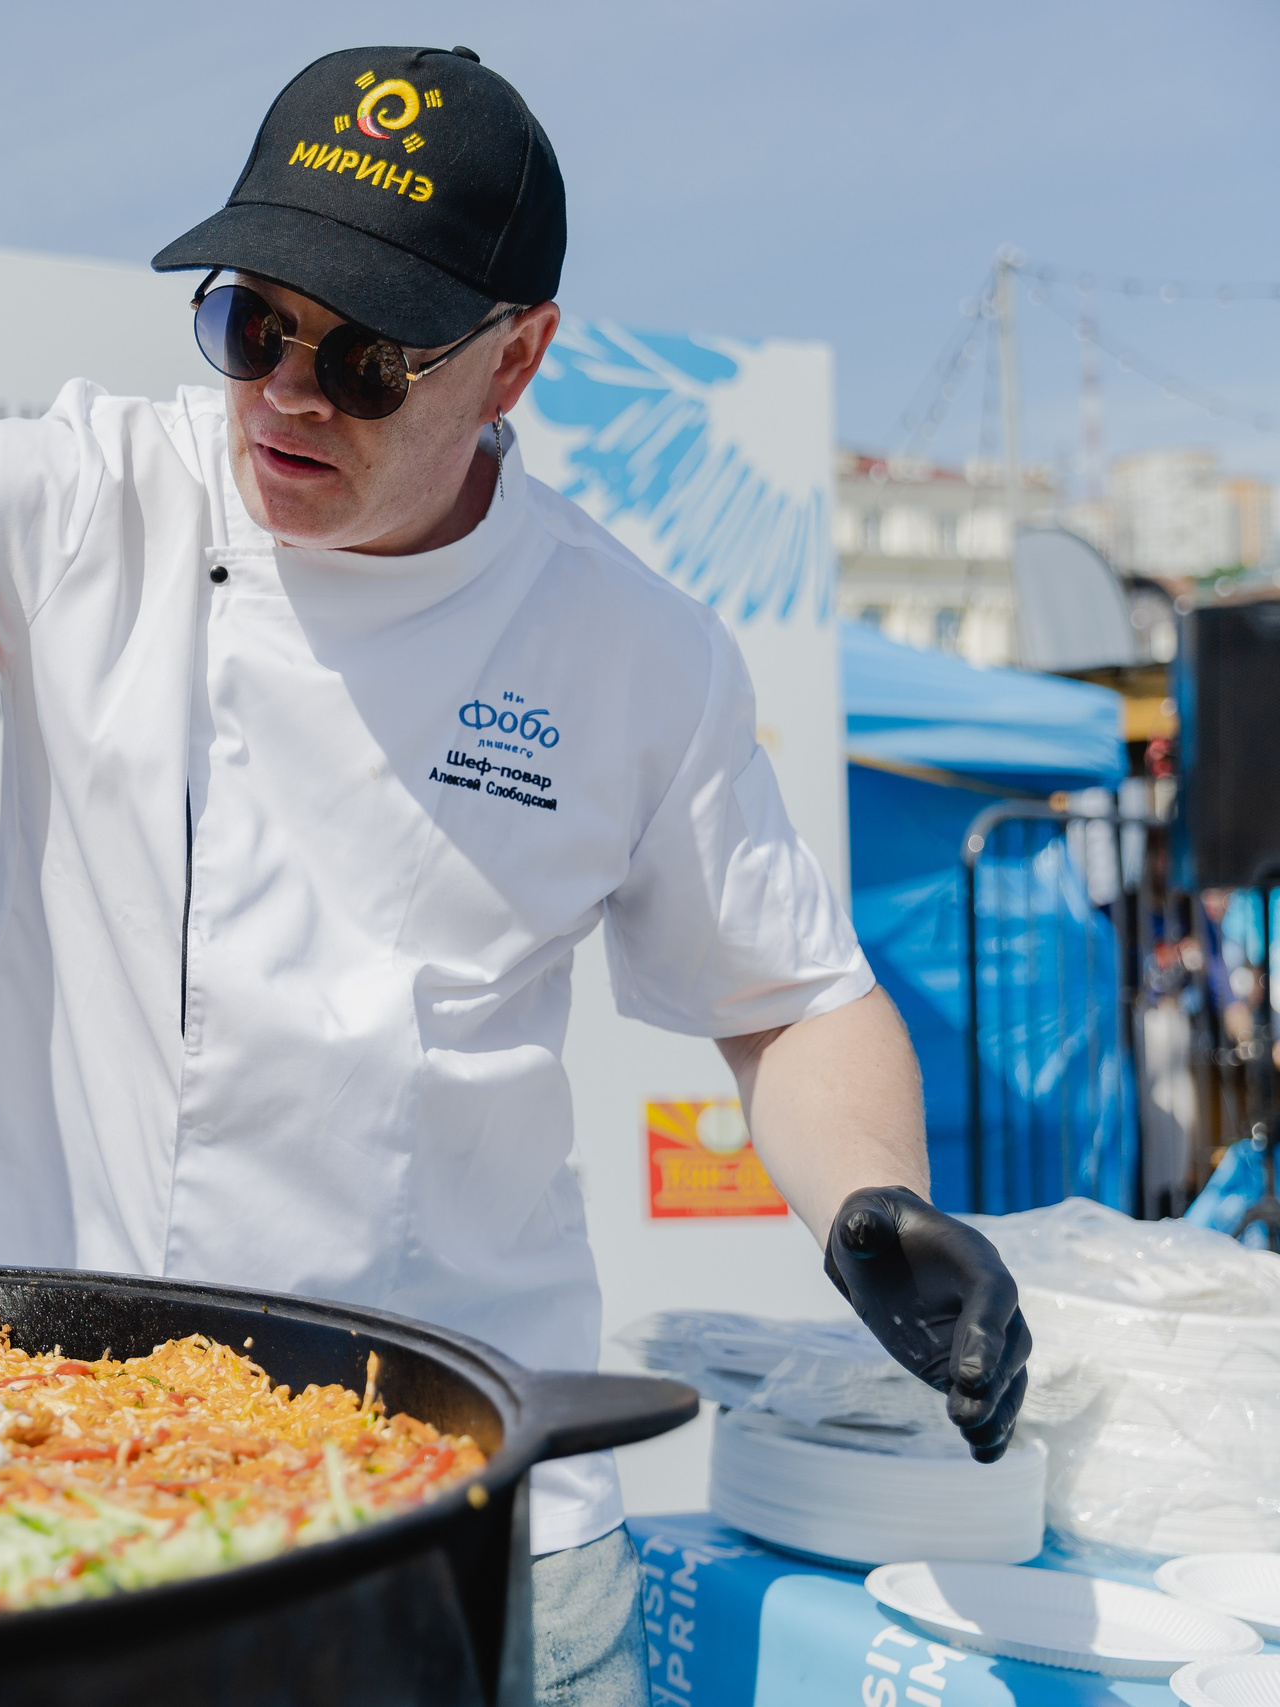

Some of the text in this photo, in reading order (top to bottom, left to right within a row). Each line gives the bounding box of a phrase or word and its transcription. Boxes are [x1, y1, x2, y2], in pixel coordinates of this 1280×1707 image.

[288, 140, 434, 202] МИРИНЭ
[458, 699, 560, 748] Фобо
[428, 767, 481, 791] Алексей
[446, 750, 552, 791] Шеф-повар
